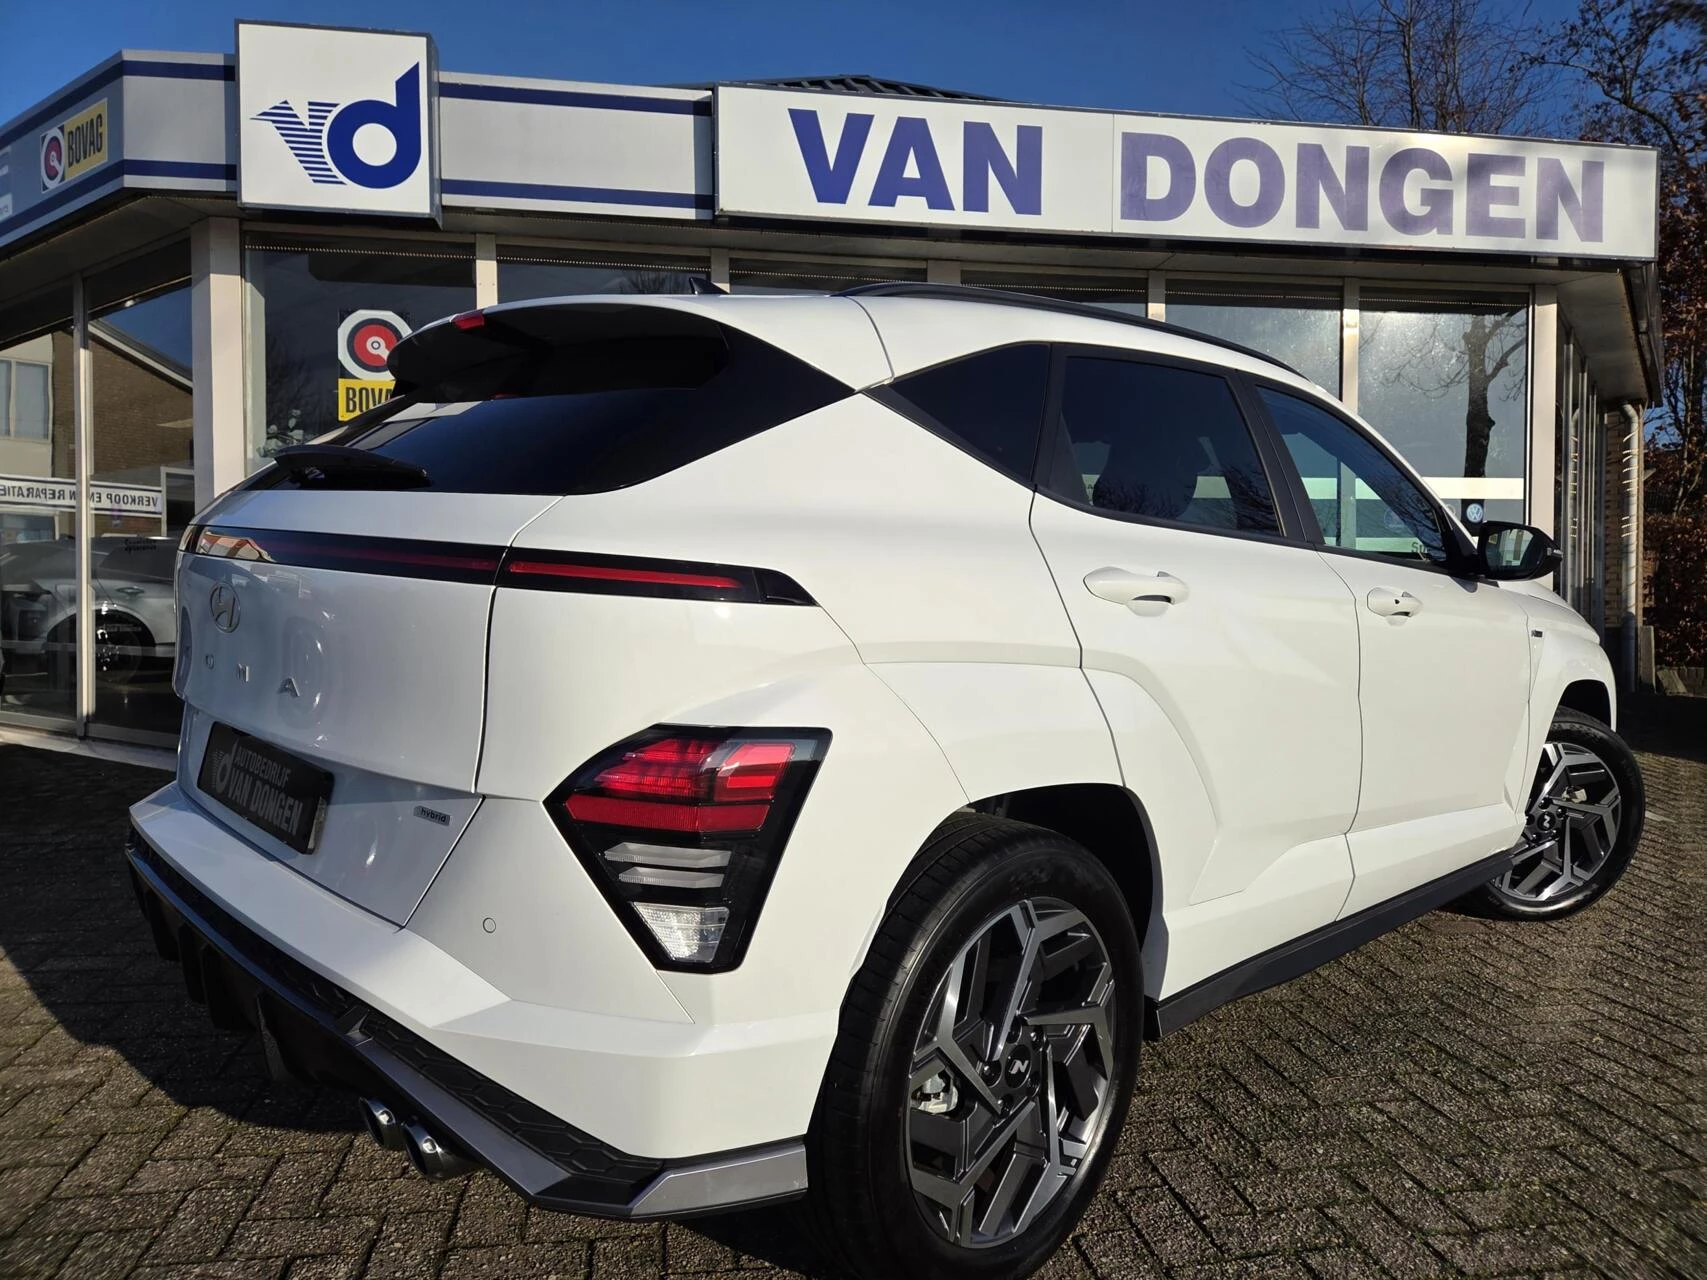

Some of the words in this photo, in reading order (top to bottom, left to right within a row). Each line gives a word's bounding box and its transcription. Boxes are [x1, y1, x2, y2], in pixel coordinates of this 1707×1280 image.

[67, 113, 103, 168] BOVAG
[788, 108, 1043, 216] VAN
[1120, 131, 1605, 243] DONGEN
[234, 745, 292, 788] AUTOBEDRIJF
[228, 767, 253, 807] VAN
[250, 780, 303, 836] DONGEN
[421, 807, 447, 823] hybrid
